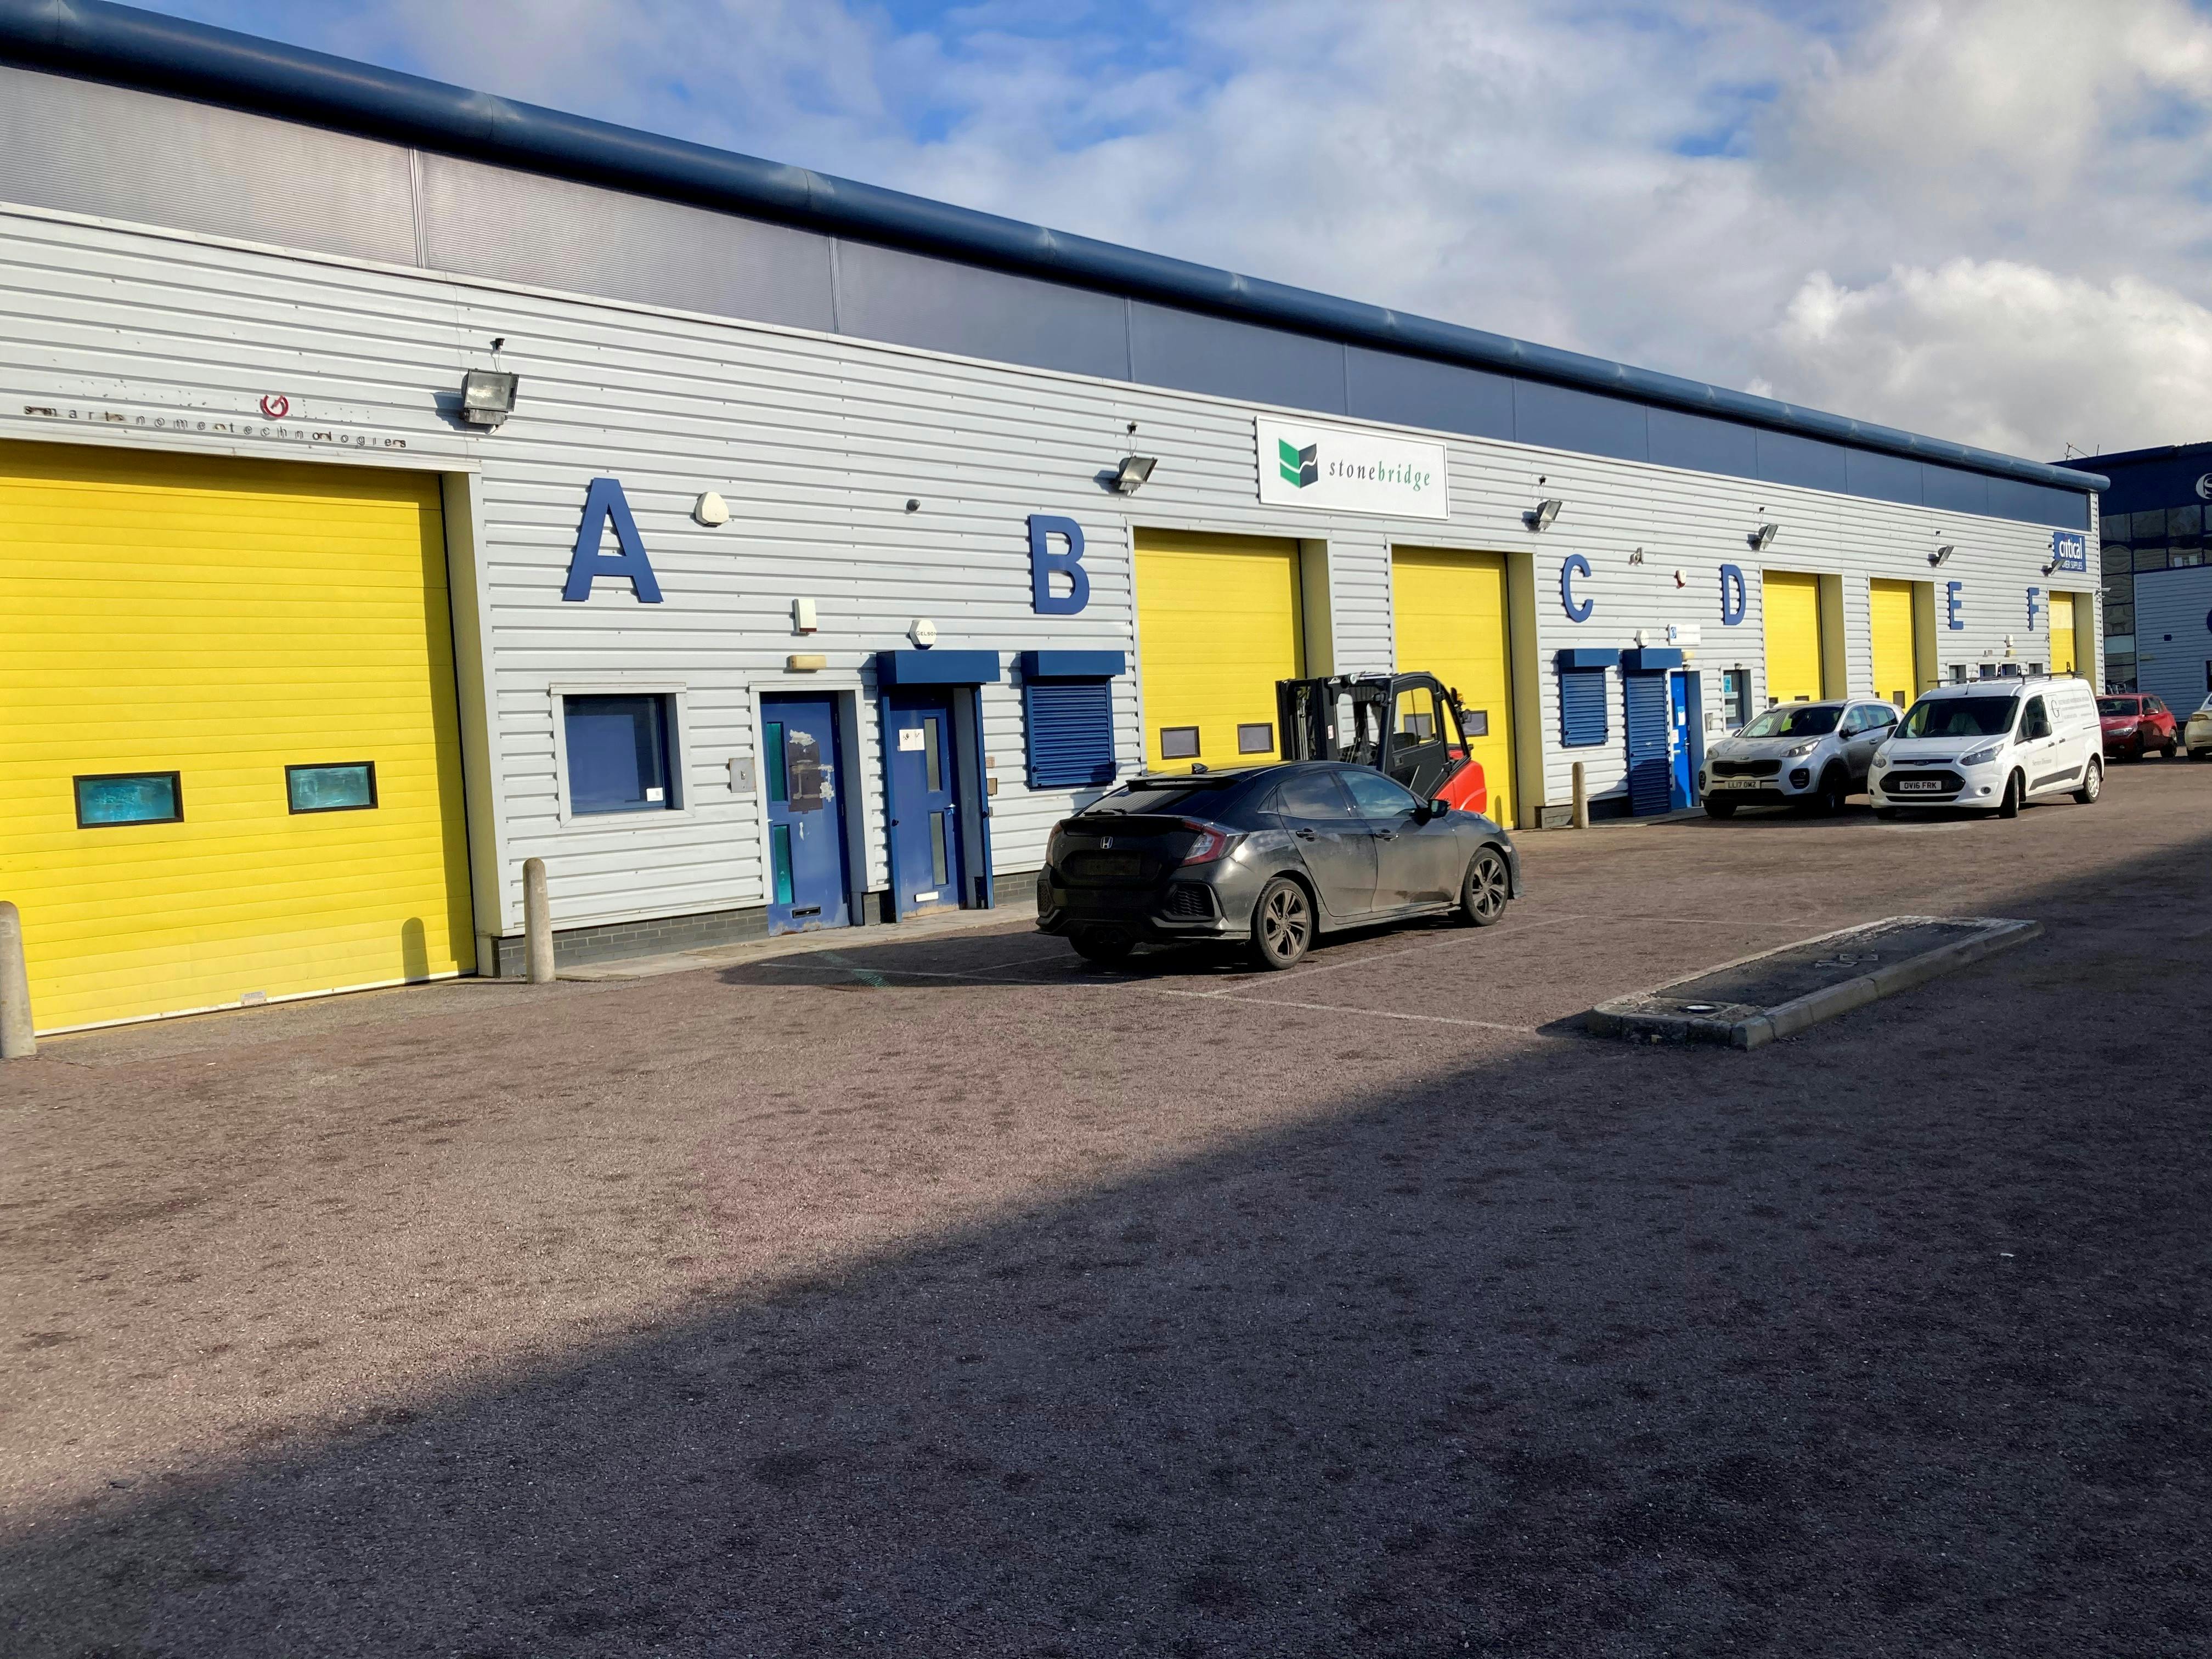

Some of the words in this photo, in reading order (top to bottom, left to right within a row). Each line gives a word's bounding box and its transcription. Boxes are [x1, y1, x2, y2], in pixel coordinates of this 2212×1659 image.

[1329, 459, 1430, 492] stonebridge
[564, 478, 663, 603] A
[1030, 515, 1090, 614] B
[2059, 537, 2083, 559] critical
[1561, 554, 1594, 623] C
[1722, 564, 1746, 625] D
[1948, 582, 1963, 630] E
[2028, 587, 2039, 631] F
